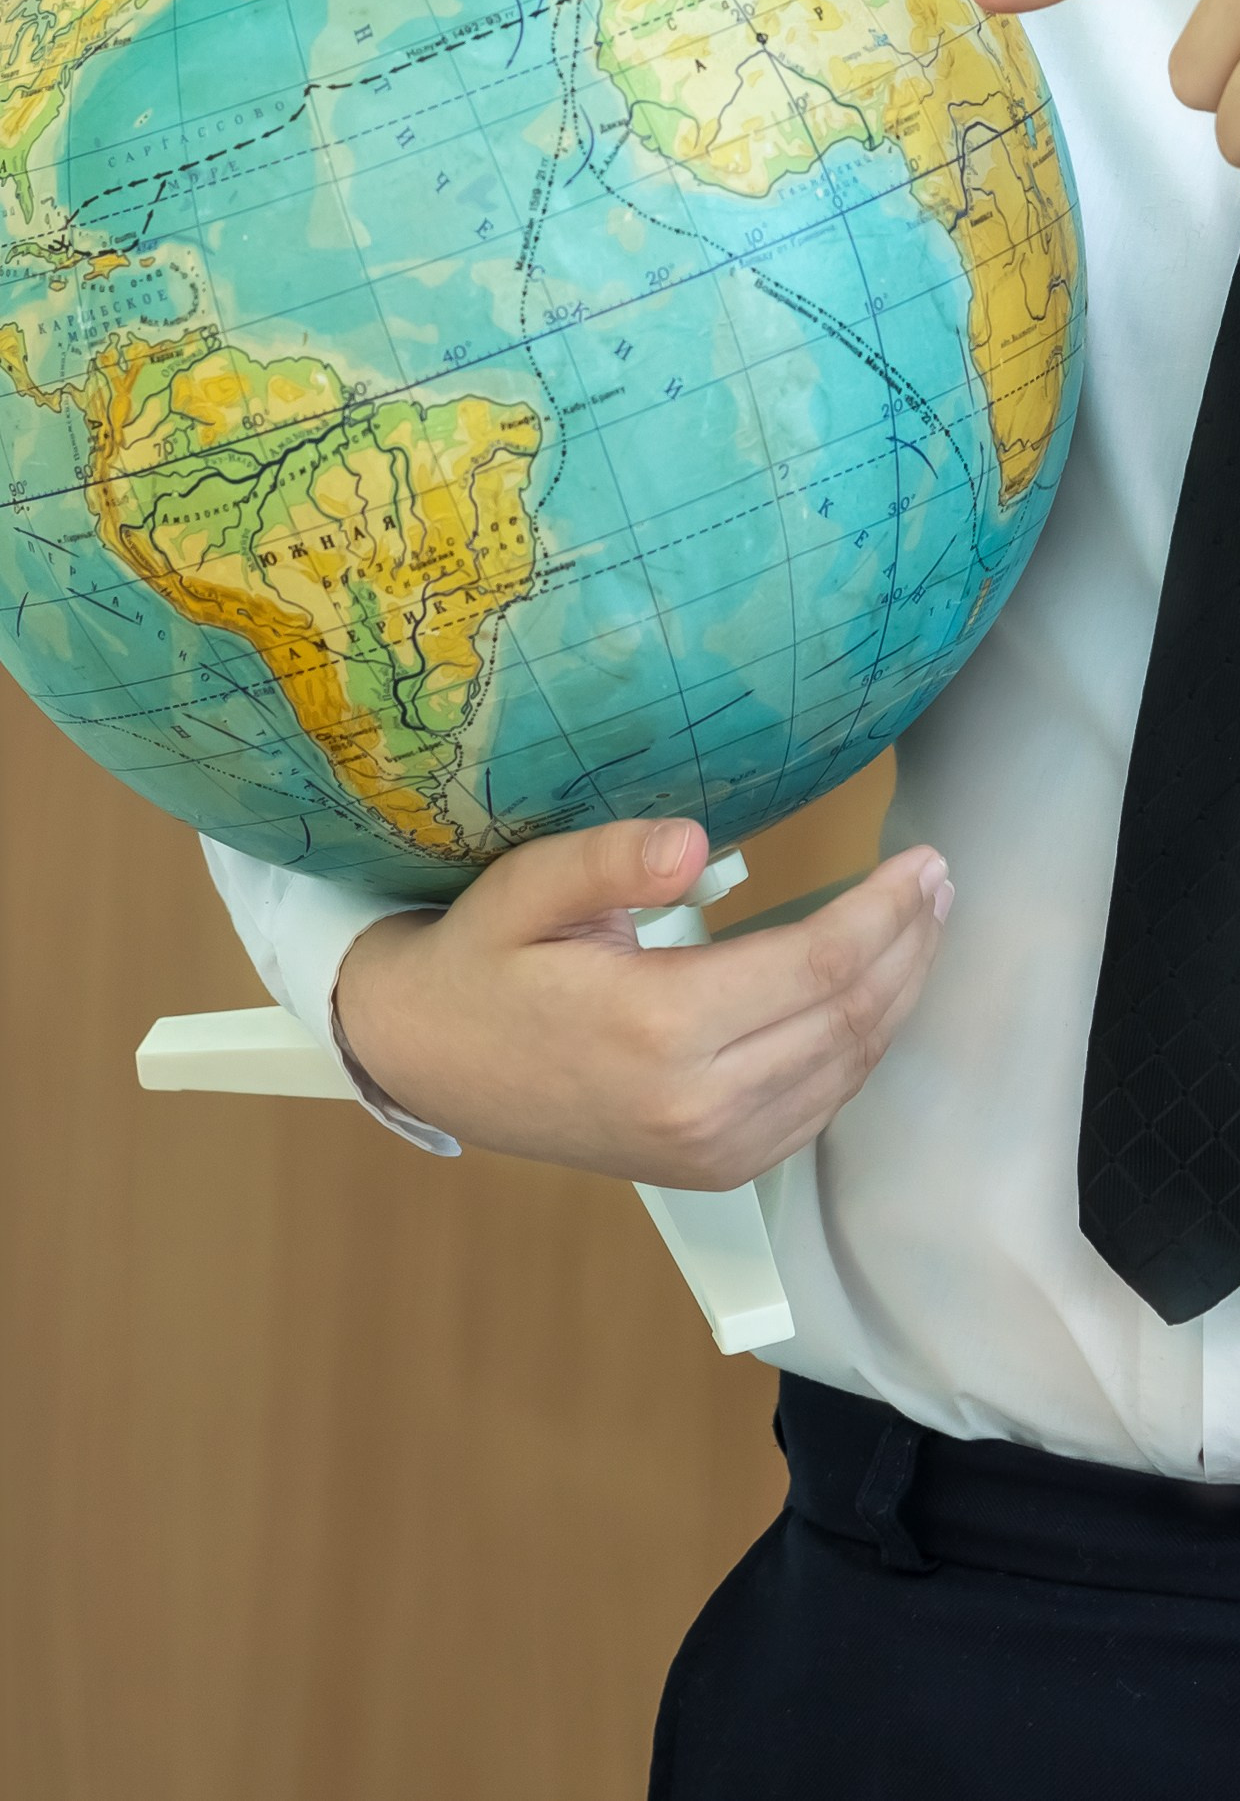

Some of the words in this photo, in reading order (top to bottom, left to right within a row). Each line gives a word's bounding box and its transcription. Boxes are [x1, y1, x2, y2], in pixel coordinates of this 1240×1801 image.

[452, 12, 502, 40] 1492-93
[107, 101, 286, 169] САРГАССОВО
[442, 342, 470, 364] 40°
[259, 514, 397, 568] ЮЖНАЯ
[289, 590, 478, 661] АМЕРИКА
